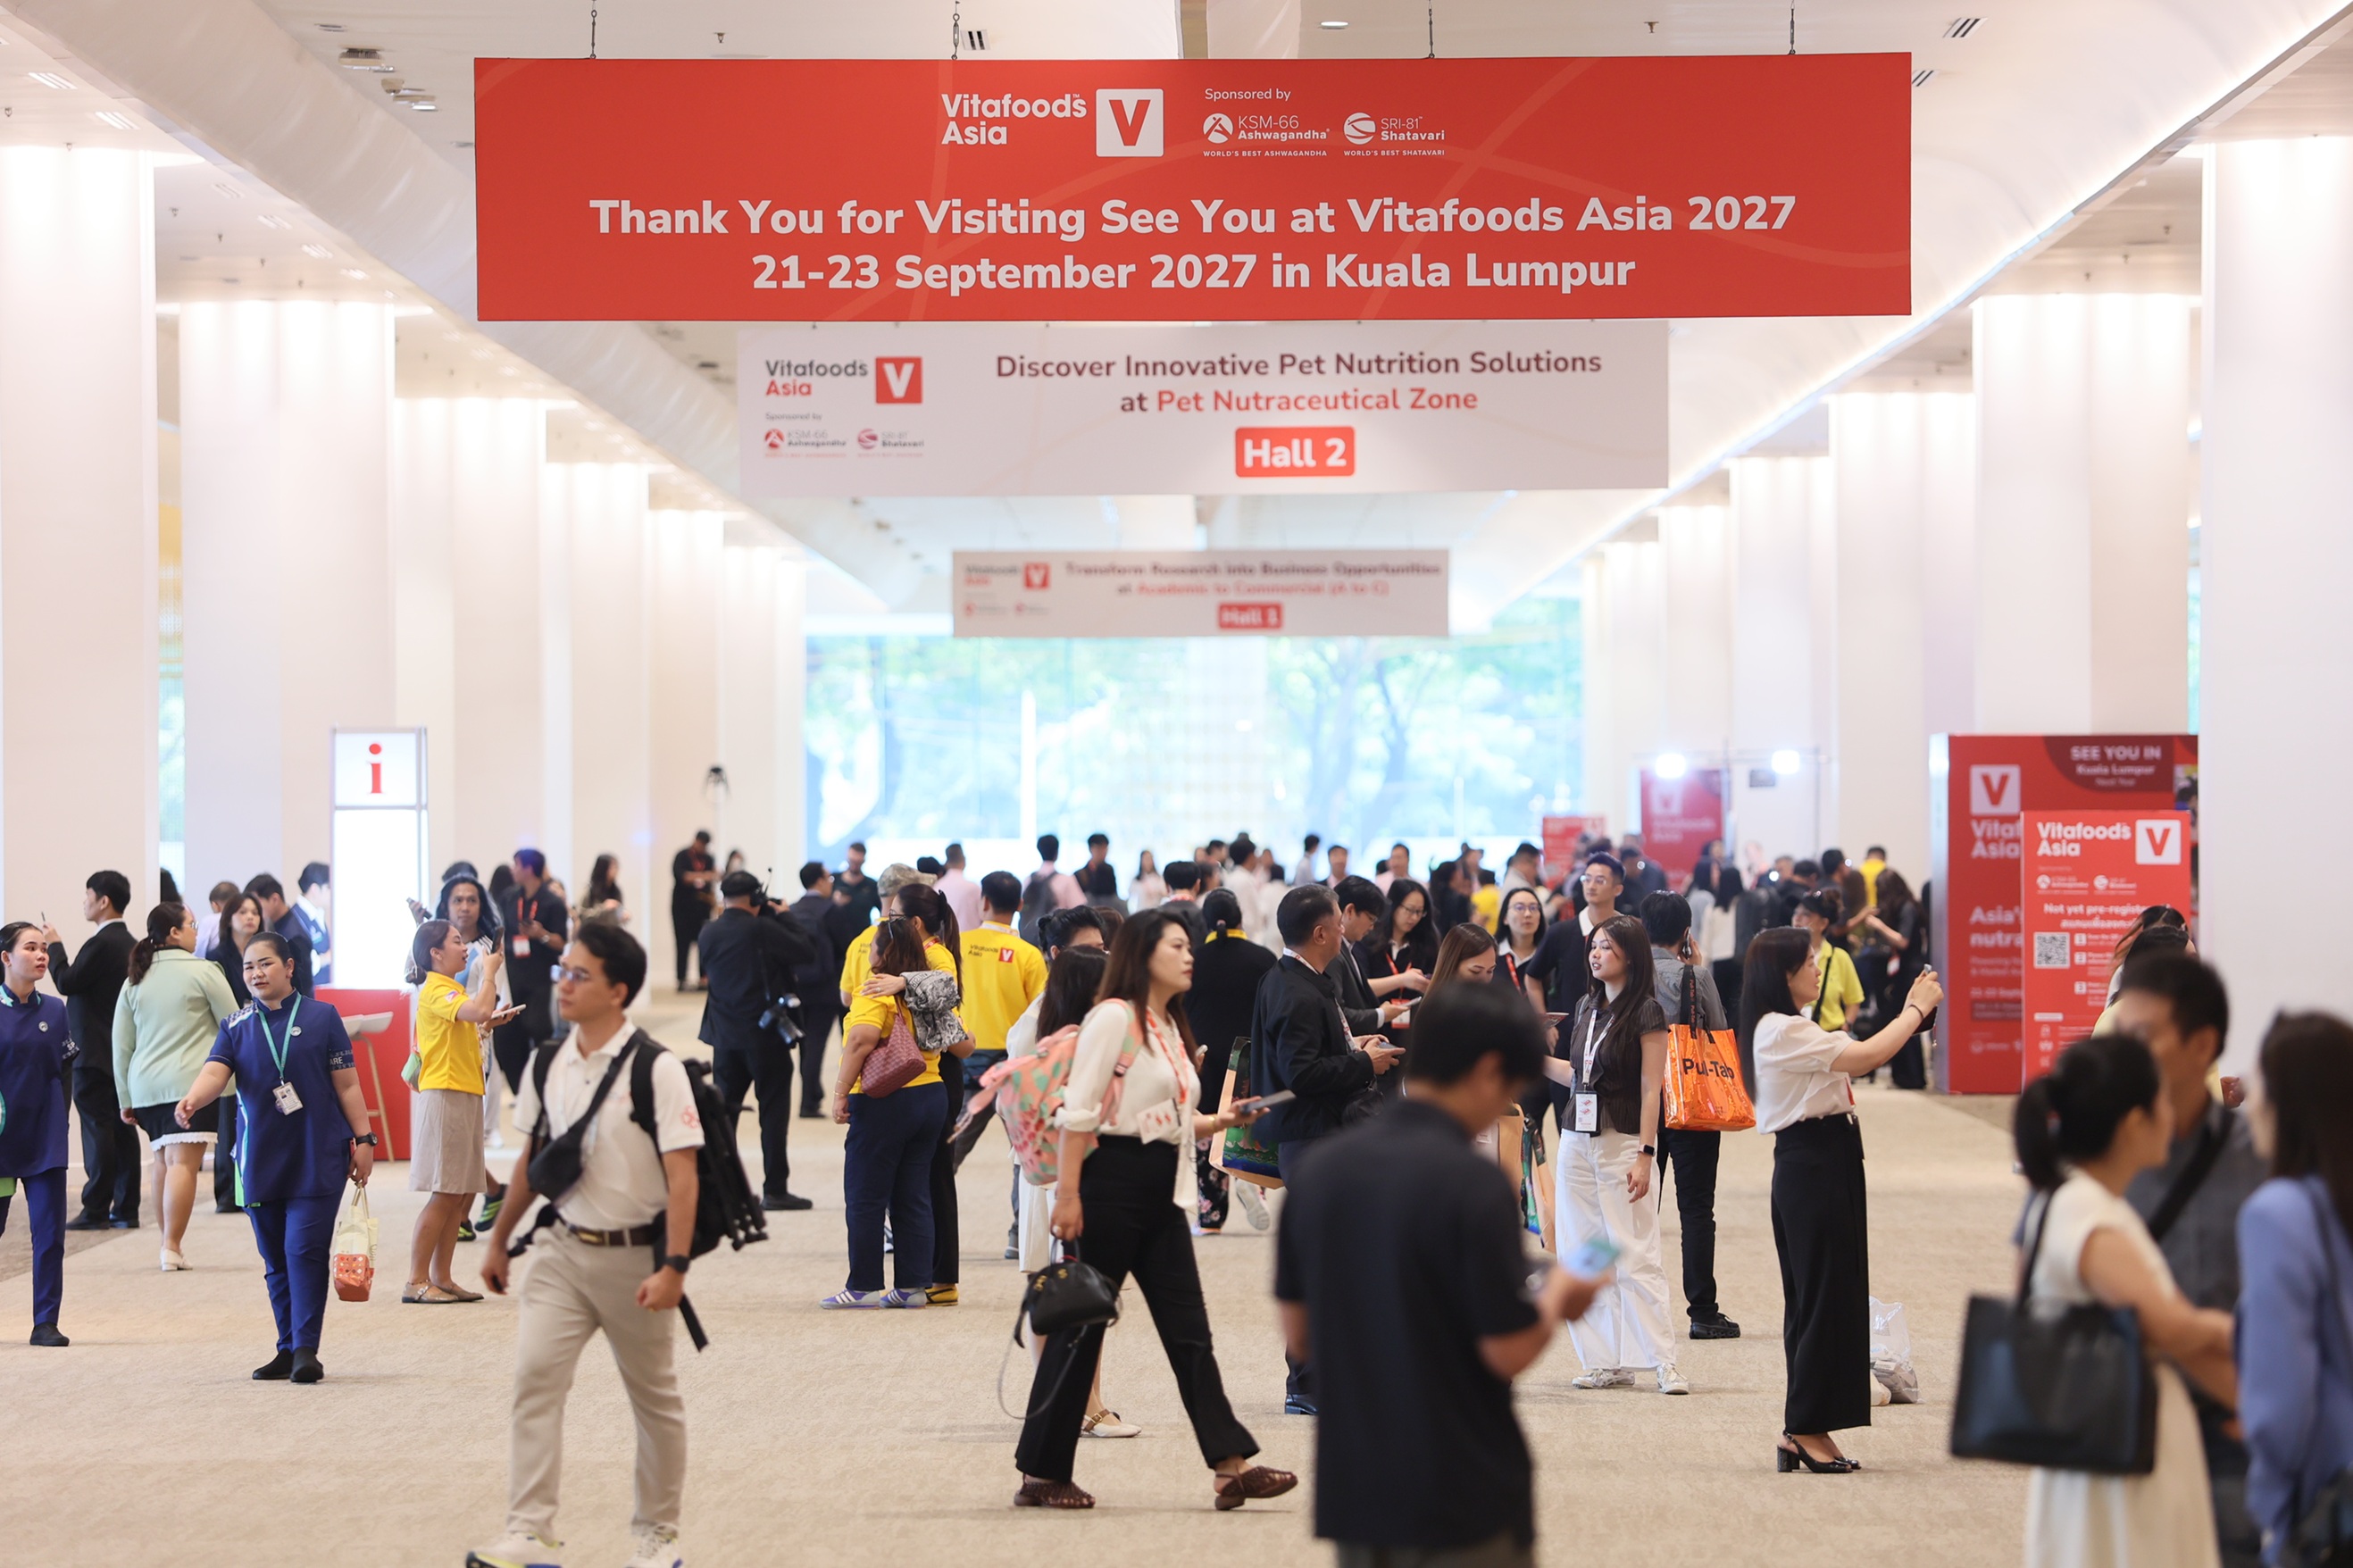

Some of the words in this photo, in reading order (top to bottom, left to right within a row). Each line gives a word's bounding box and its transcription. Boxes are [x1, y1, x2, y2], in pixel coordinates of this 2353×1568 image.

[1205, 88, 1273, 102] Sponsored
[1275, 88, 1291, 102] by
[1108, 99, 1152, 146] V
[1238, 114, 1299, 129] KSM-66
[941, 121, 1008, 145] Asia
[1381, 129, 1445, 141] Shatavari
[589, 200, 729, 234] Thank
[738, 200, 823, 234] You
[838, 200, 904, 234] for
[915, 198, 1085, 242] Visiting
[1101, 199, 1179, 234] See
[1191, 199, 1275, 233] You
[1290, 202, 1335, 233] at
[1347, 196, 1564, 232] Vitafoods
[1576, 196, 1673, 230] Asia
[1688, 196, 1796, 229] 2027
[752, 254, 880, 288] 21-23
[896, 254, 1136, 296] September
[1150, 254, 1257, 288] 2027
[1272, 253, 1310, 288] in
[1326, 253, 1450, 288] Kuala
[1466, 253, 1636, 294] Lumpur
[997, 355, 1116, 378] Discover
[1124, 354, 1270, 377] Innovative
[1279, 353, 1326, 375] Pet
[1335, 352, 1460, 374] Nutrition
[1470, 350, 1602, 372] Solutions
[765, 379, 813, 396] Asia
[882, 362, 916, 399] V
[1121, 393, 1148, 412] at
[1157, 390, 1204, 412] Pet
[1213, 388, 1401, 411] Nutraceutical
[1410, 388, 1479, 410] Zone
[765, 412, 810, 421] Sponsored
[812, 412, 822, 421] by
[1244, 438, 1317, 468] Hall
[1325, 438, 1348, 468] 2
[2070, 746, 2100, 760] SEE
[2104, 746, 2140, 760] YOU
[2142, 745, 2162, 760] IN
[2075, 764, 2109, 775] Kuala
[2111, 764, 2156, 776] Lumpur
[1981, 773, 2011, 807] V
[2036, 822, 2132, 840] Vitafoods
[2036, 840, 2082, 857] Asia
[2145, 827, 2172, 857] V
[1970, 905, 2023, 925] Asia'
[2043, 903, 2065, 914] Not
[2066, 904, 2084, 915] yet
